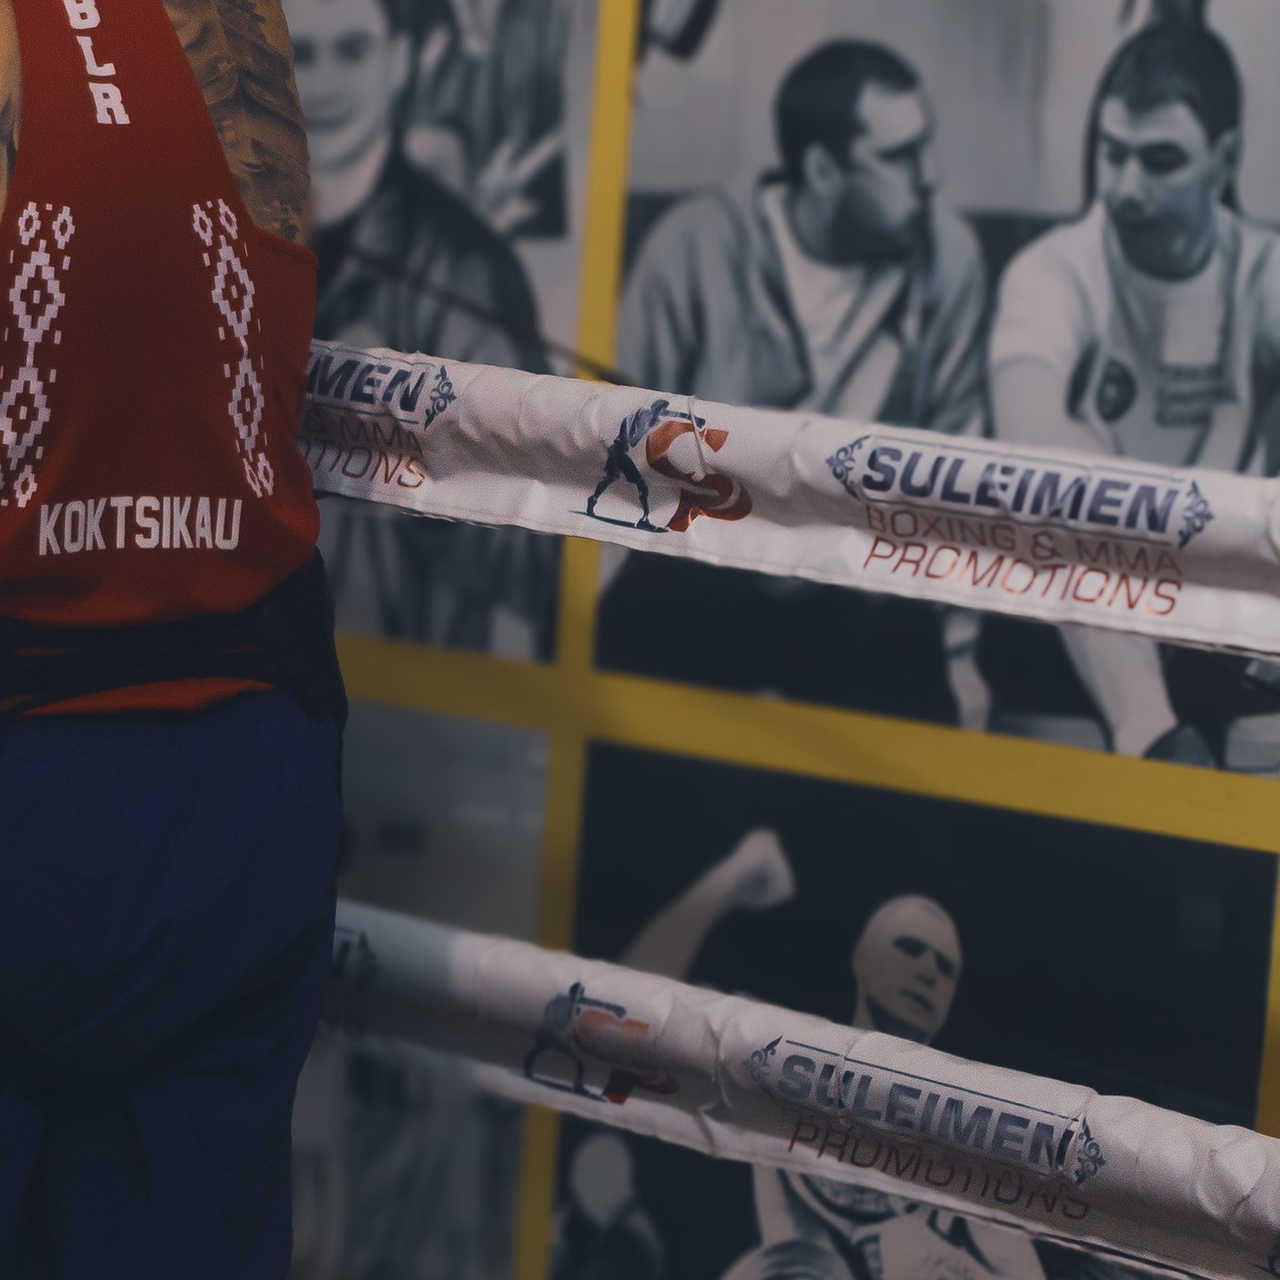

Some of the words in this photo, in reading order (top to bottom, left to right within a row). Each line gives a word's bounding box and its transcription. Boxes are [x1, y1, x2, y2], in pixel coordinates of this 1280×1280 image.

[38, 496, 243, 557] KOKTSIKAU
[861, 445, 1179, 534] SULEIMEN
[862, 536, 1184, 616] PROMOTIONS
[865, 503, 1017, 552] BOXING
[1030, 530, 1063, 561] &
[1075, 538, 1183, 576] MMA
[778, 1053, 1075, 1171] SULEIMEN
